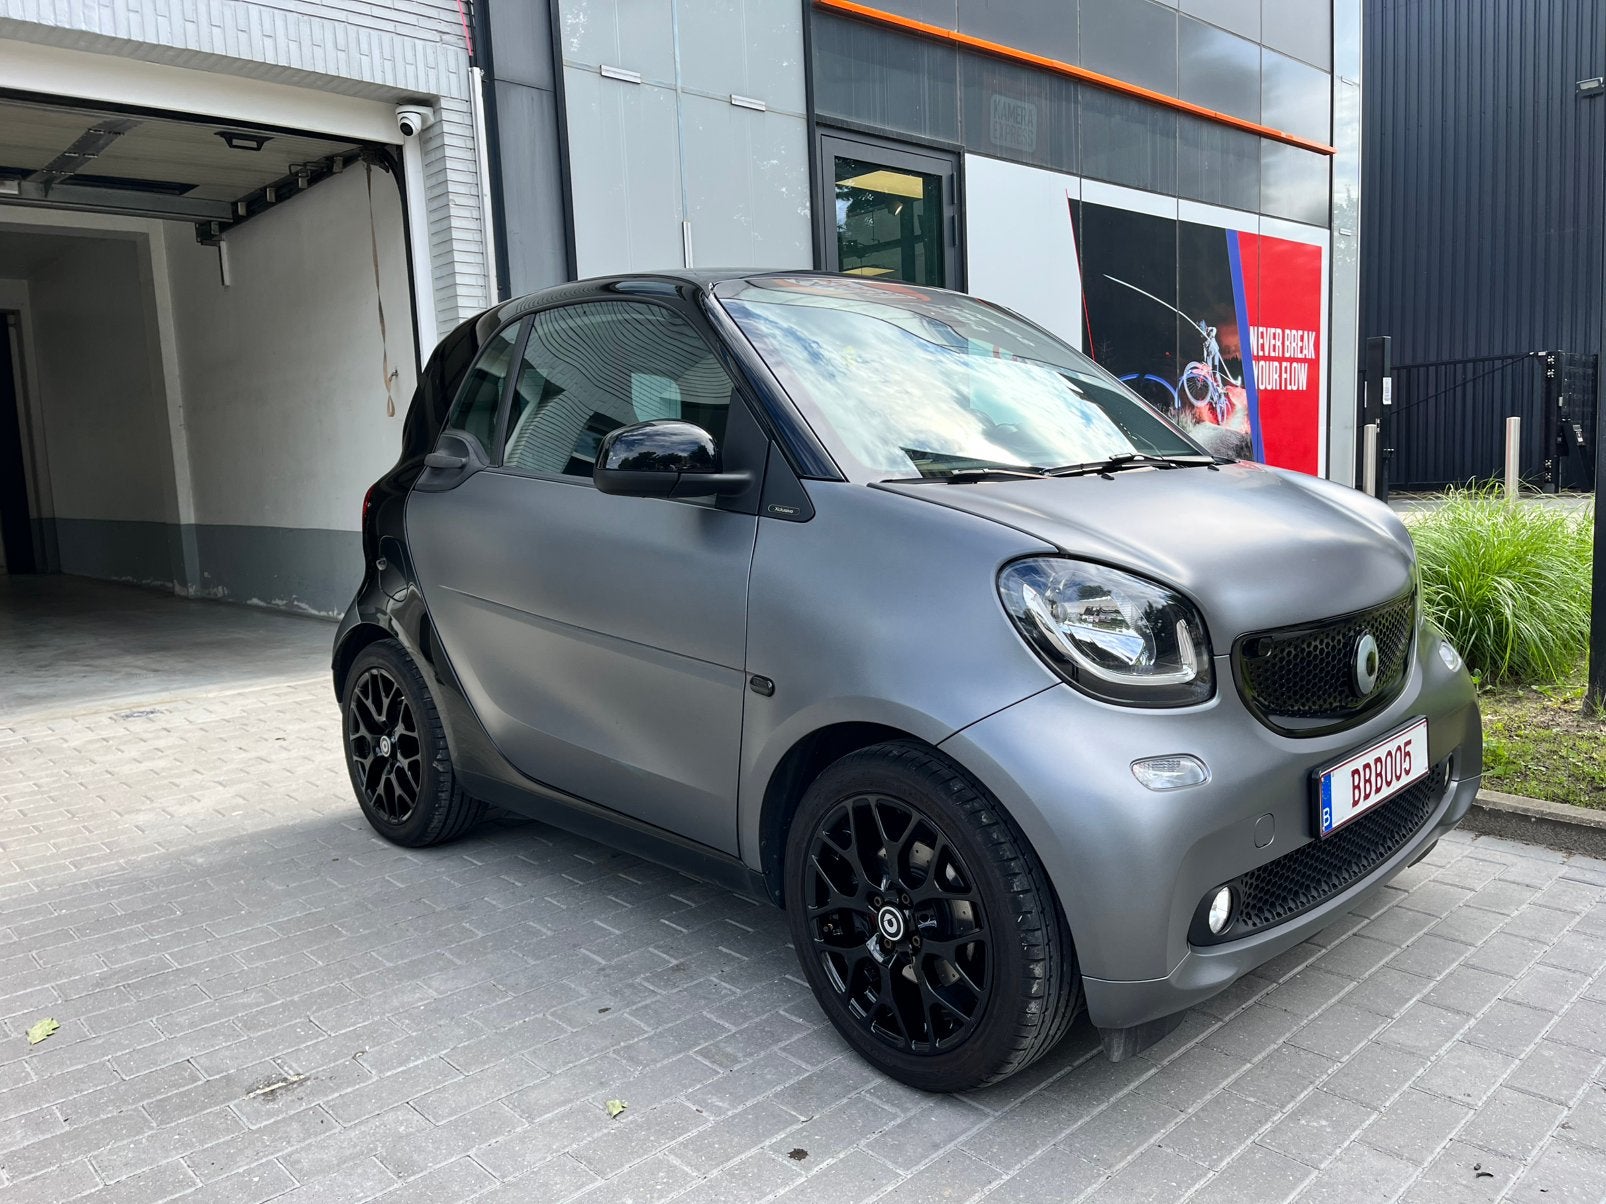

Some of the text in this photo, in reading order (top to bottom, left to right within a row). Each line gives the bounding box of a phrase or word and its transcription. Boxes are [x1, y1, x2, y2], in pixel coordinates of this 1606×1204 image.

[993, 99, 1033, 128] KAMERA
[993, 119, 1034, 146] EXPRESS
[1249, 326, 1316, 359] NEVER BREAK
[1252, 360, 1308, 391] YOUR FLOW
[1351, 739, 1412, 809] BBB005
[1323, 808, 1331, 826] B
